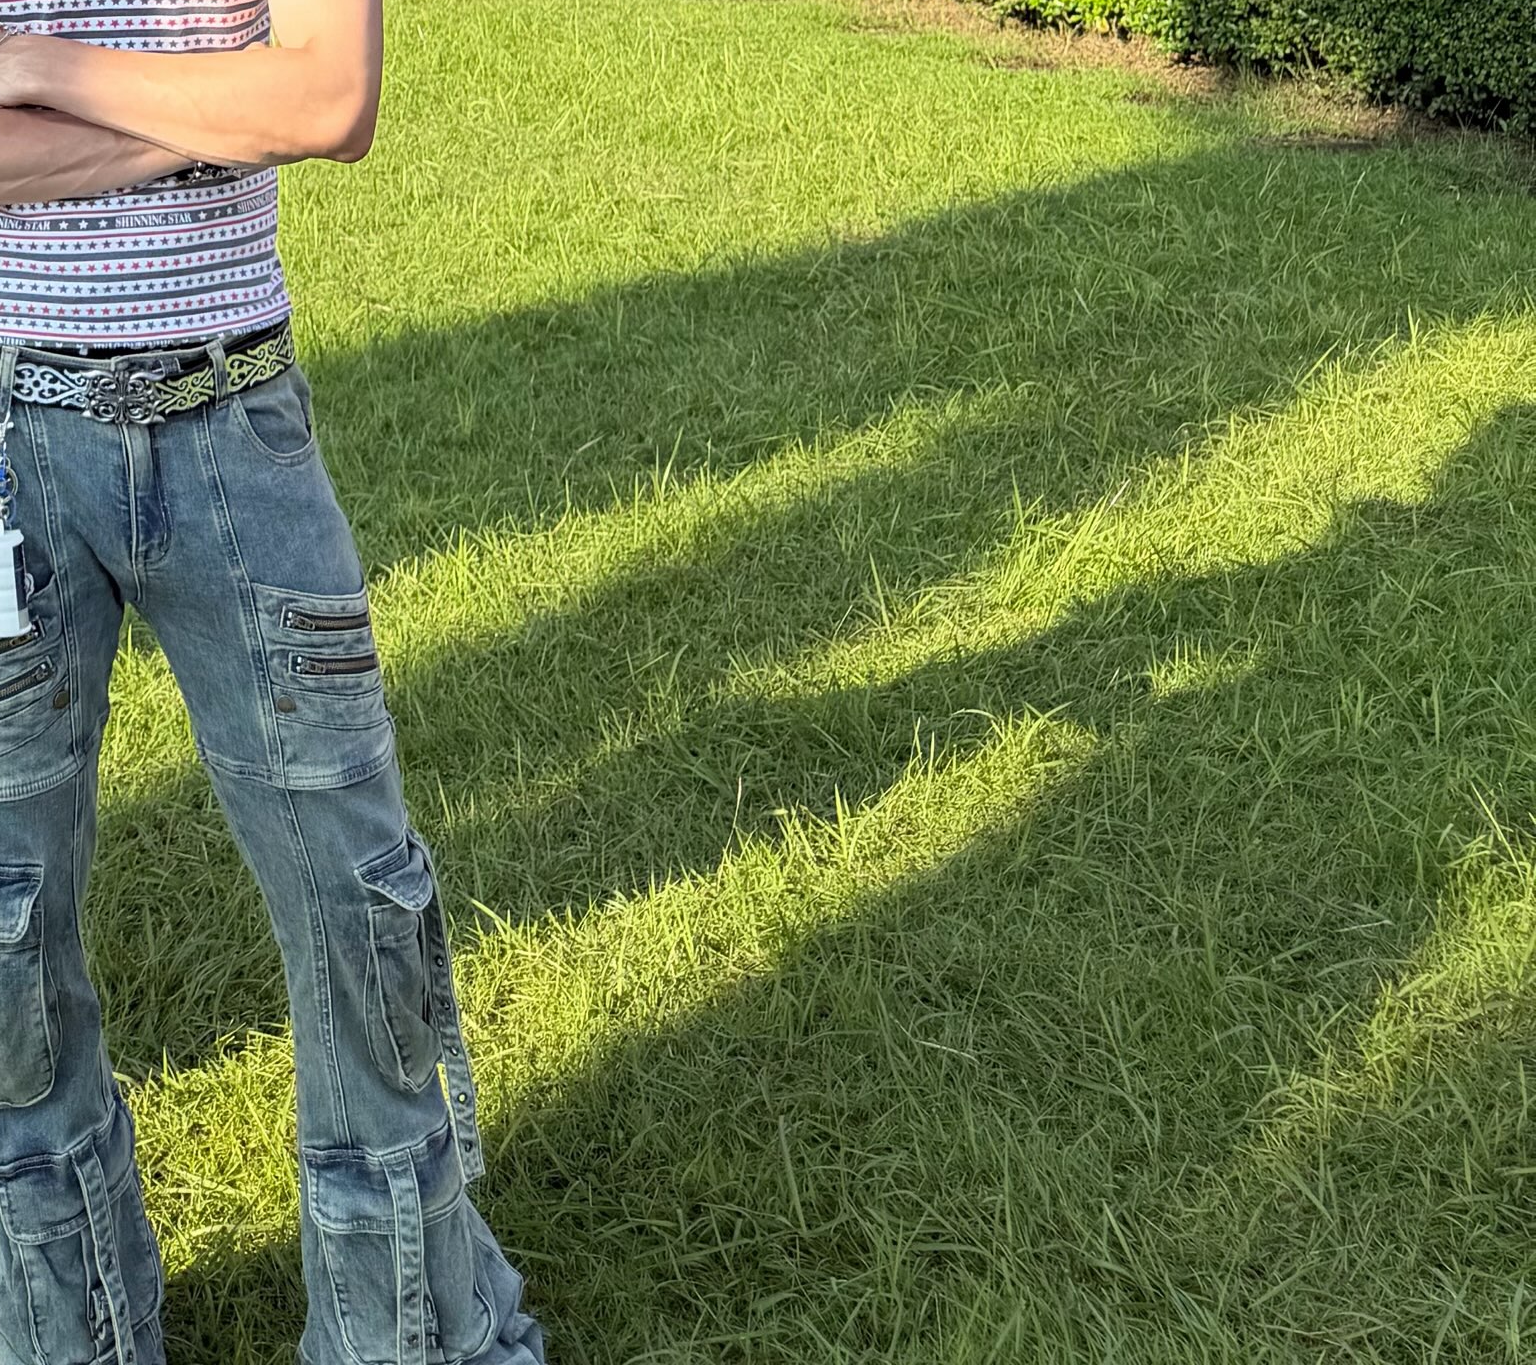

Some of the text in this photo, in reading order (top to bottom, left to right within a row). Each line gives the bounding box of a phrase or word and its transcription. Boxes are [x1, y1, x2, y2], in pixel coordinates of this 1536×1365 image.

[24, 220, 51, 232] STAR
[115, 212, 193, 228] SHINNING STAR
